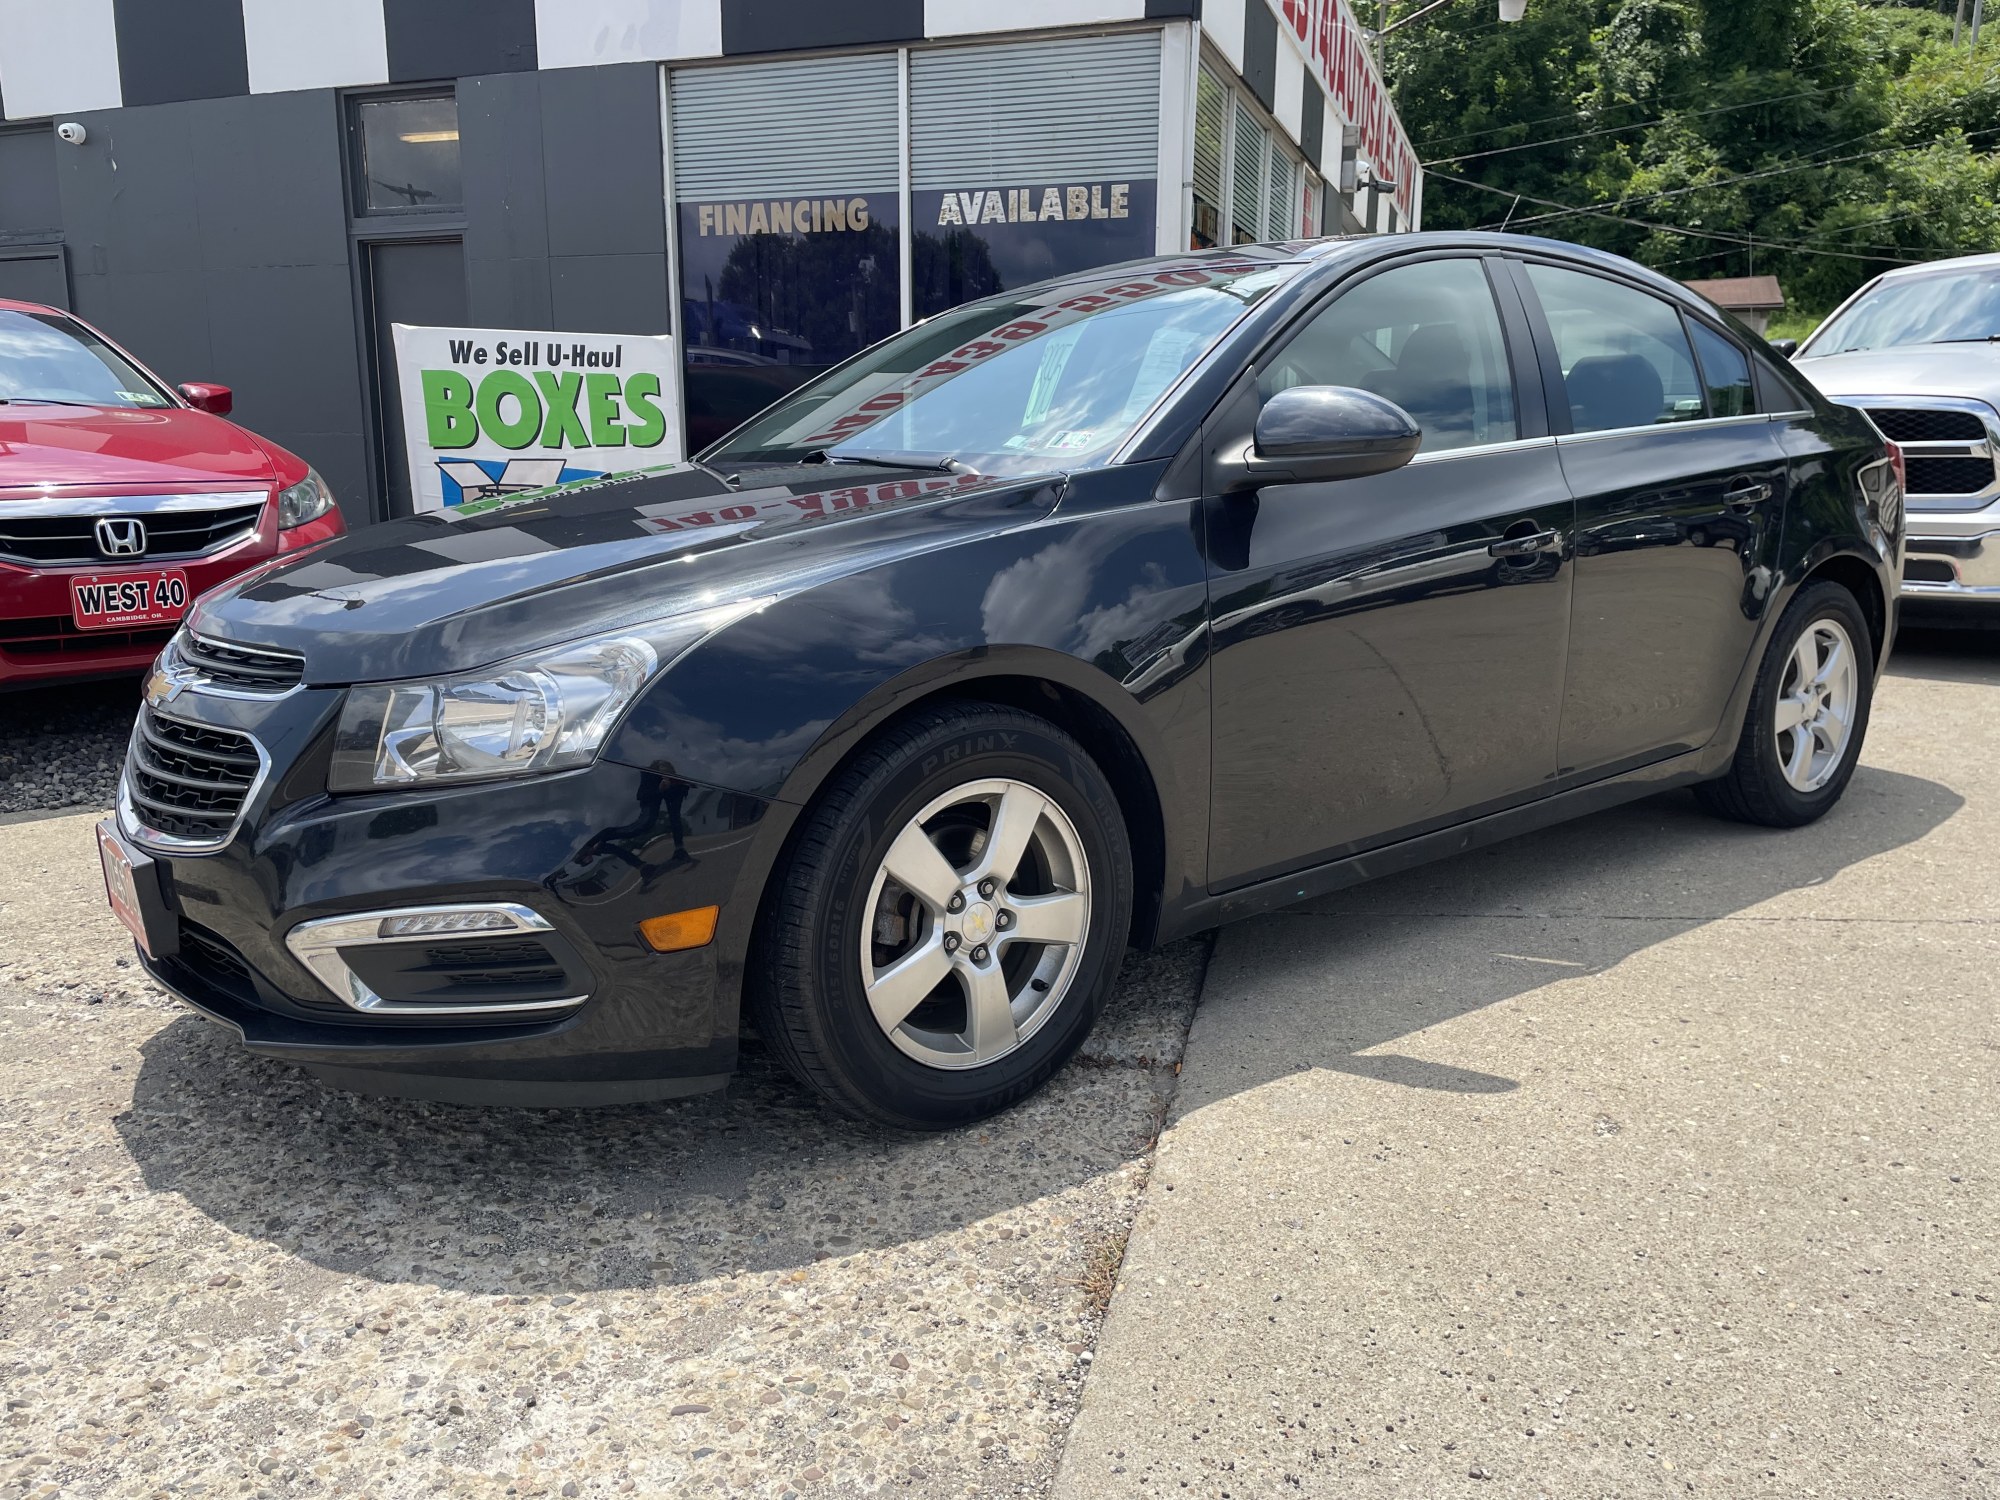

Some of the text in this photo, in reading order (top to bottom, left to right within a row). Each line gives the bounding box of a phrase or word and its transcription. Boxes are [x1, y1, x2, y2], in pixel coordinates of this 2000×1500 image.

[698, 197, 869, 237] FINANCING
[937, 183, 1130, 226] AVAILABLE
[449, 339, 622, 368] We Sell U-Haul
[420, 369, 667, 450] BOXES
[75, 578, 185, 615] WEST 40
[921, 732, 1019, 776] PRINX
